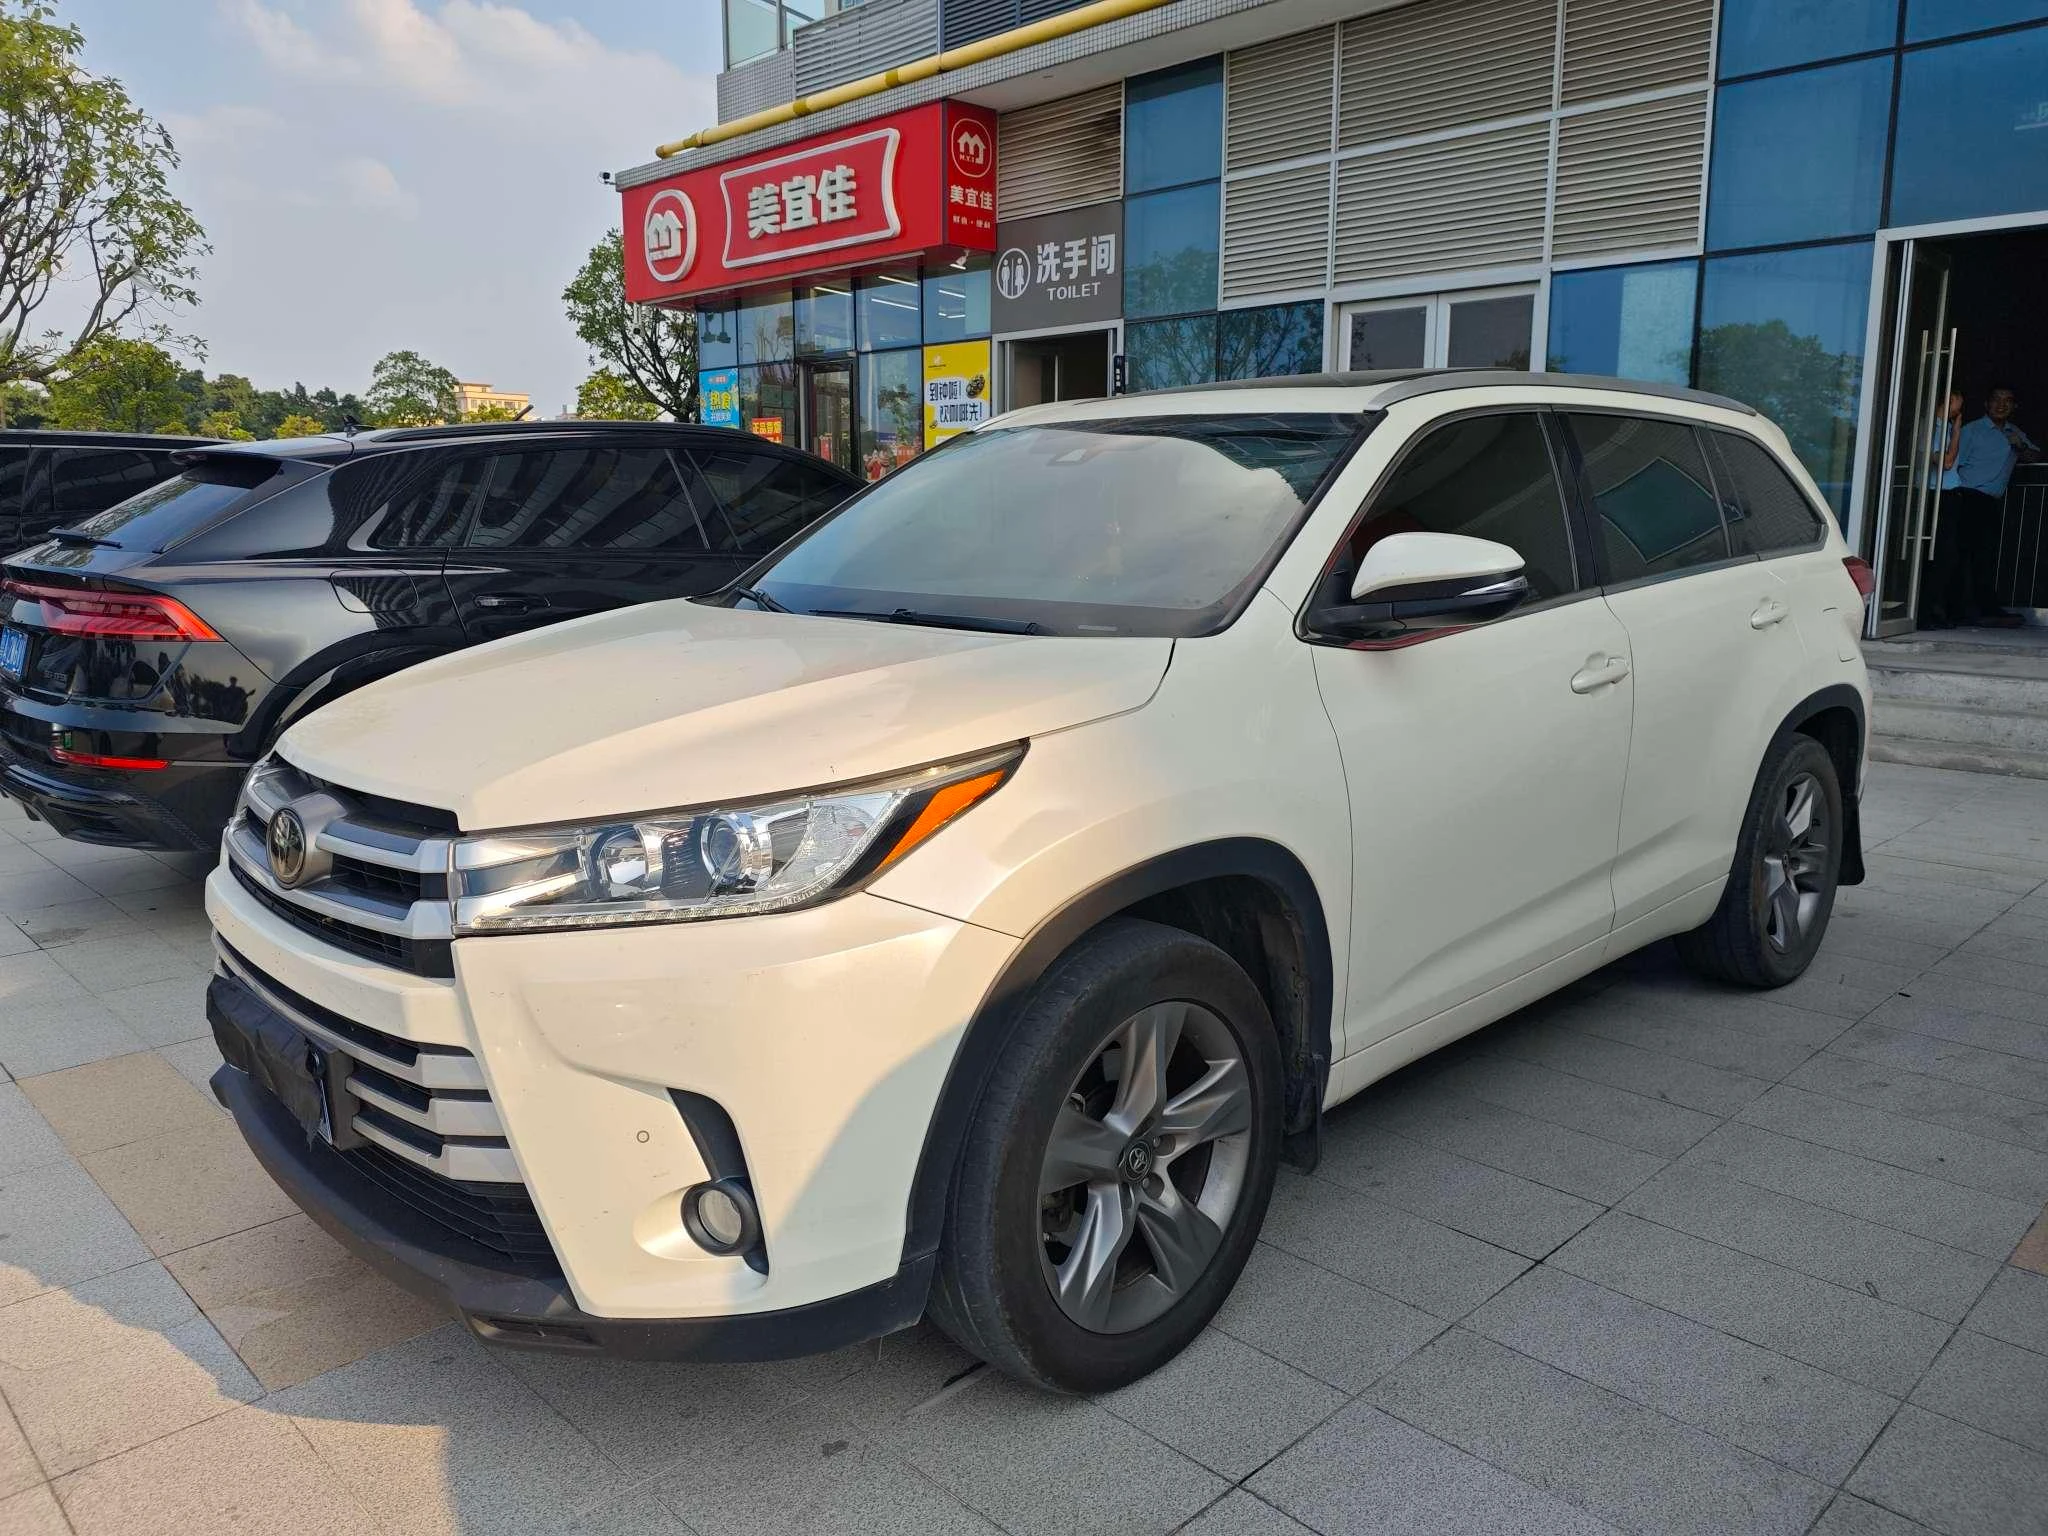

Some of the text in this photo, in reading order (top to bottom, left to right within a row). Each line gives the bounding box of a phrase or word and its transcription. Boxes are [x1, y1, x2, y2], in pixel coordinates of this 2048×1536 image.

[747, 164, 858, 240] 美宜佳
[950, 184, 993, 210] 美宜佳
[1036, 233, 1116, 284] 洗手间
[1047, 281, 1101, 301] TOILET
